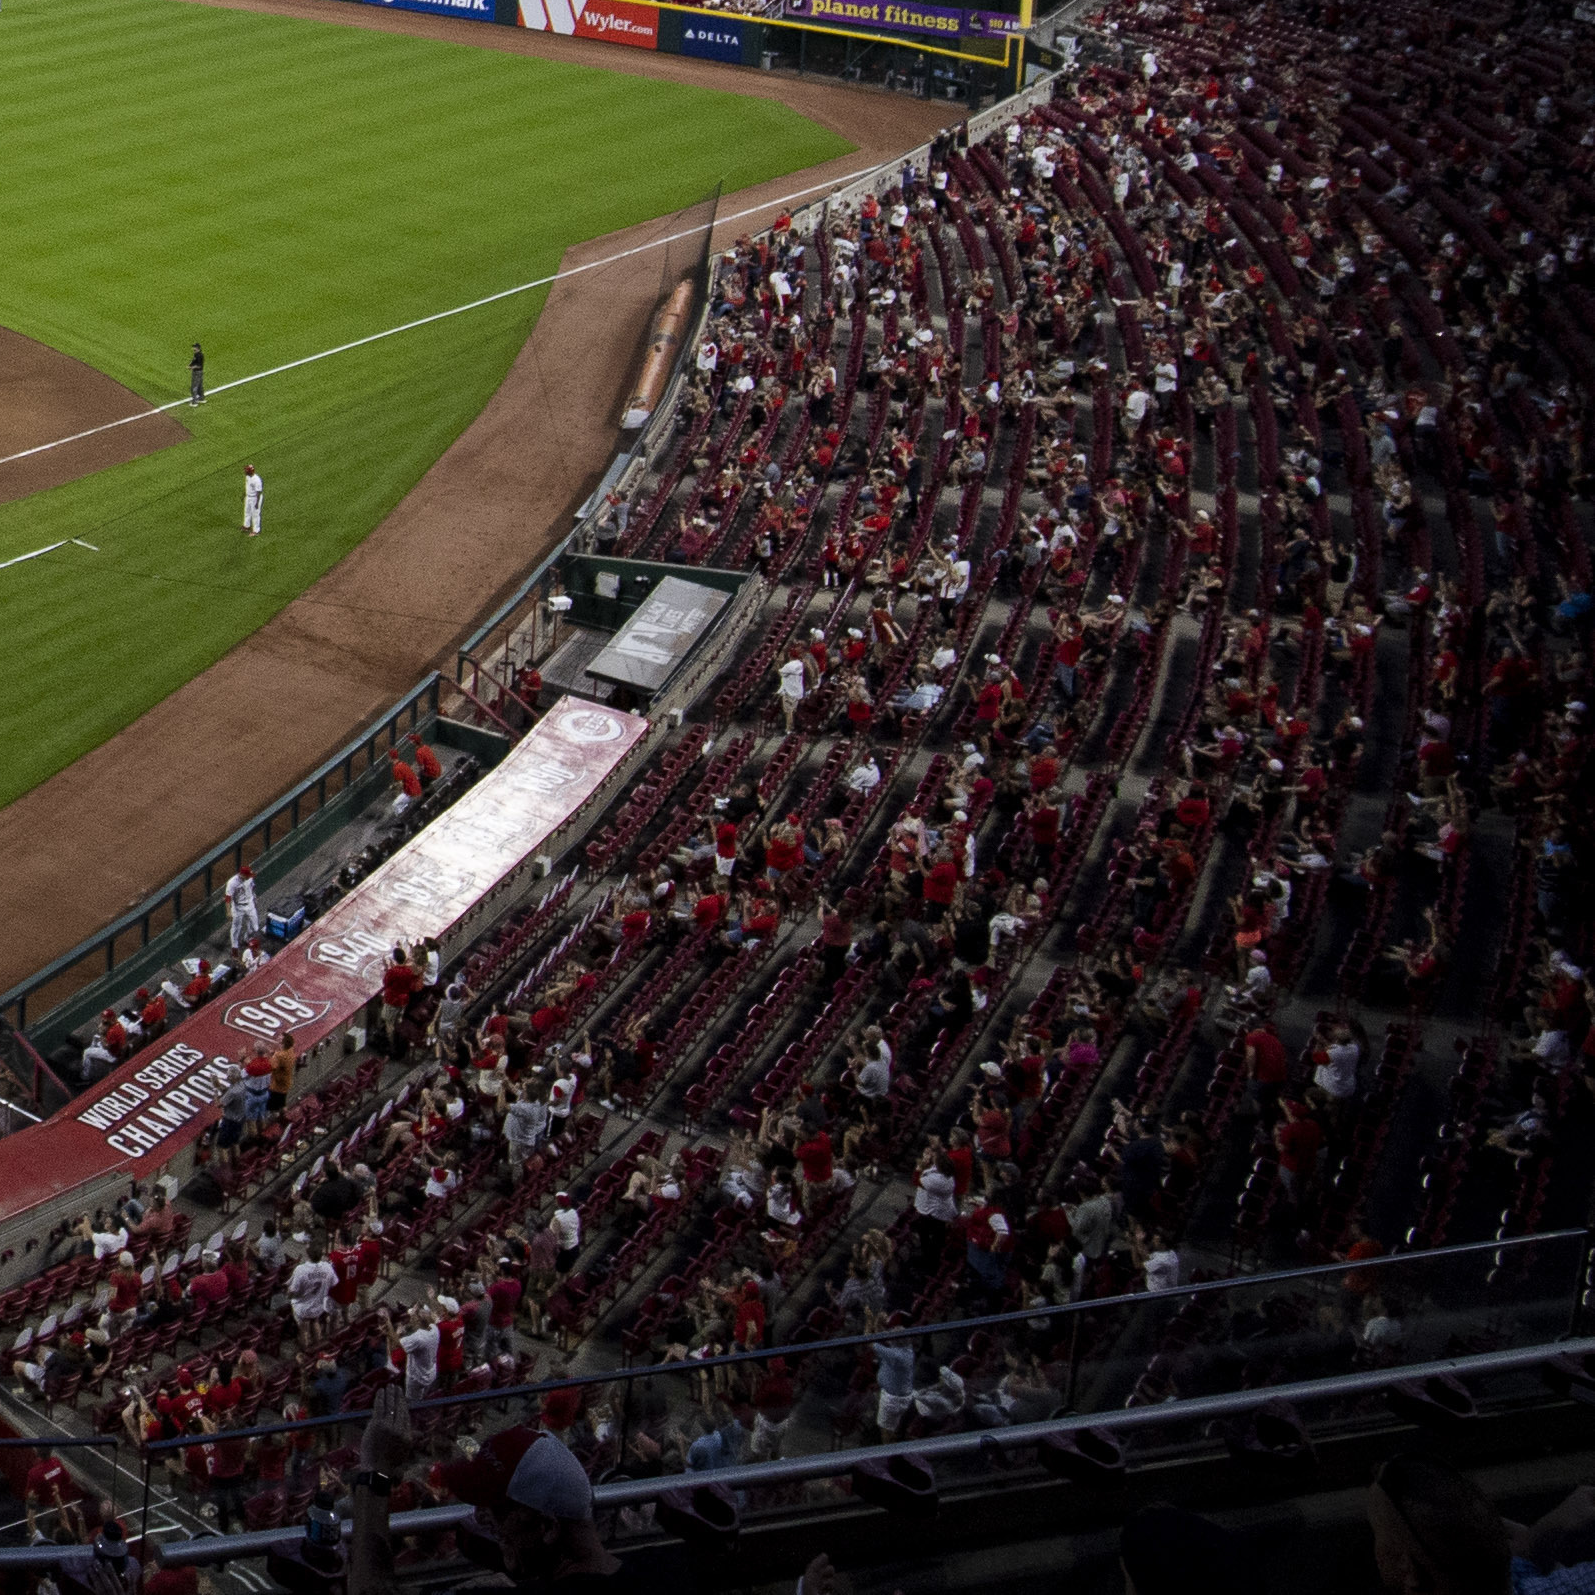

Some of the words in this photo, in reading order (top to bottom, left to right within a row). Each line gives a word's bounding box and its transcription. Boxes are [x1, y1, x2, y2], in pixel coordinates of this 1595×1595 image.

[584, 10, 654, 36] Wyler.com
[697, 30, 739, 46] DELTA
[883, 4, 960, 33] fitness
[316, 930, 392, 972] 1940
[233, 995, 315, 1037] 1919
[76, 1080, 151, 1132] WORLD
[134, 1042, 205, 1091] SERIES
[107, 1055, 240, 1159] CHAMPIONS
